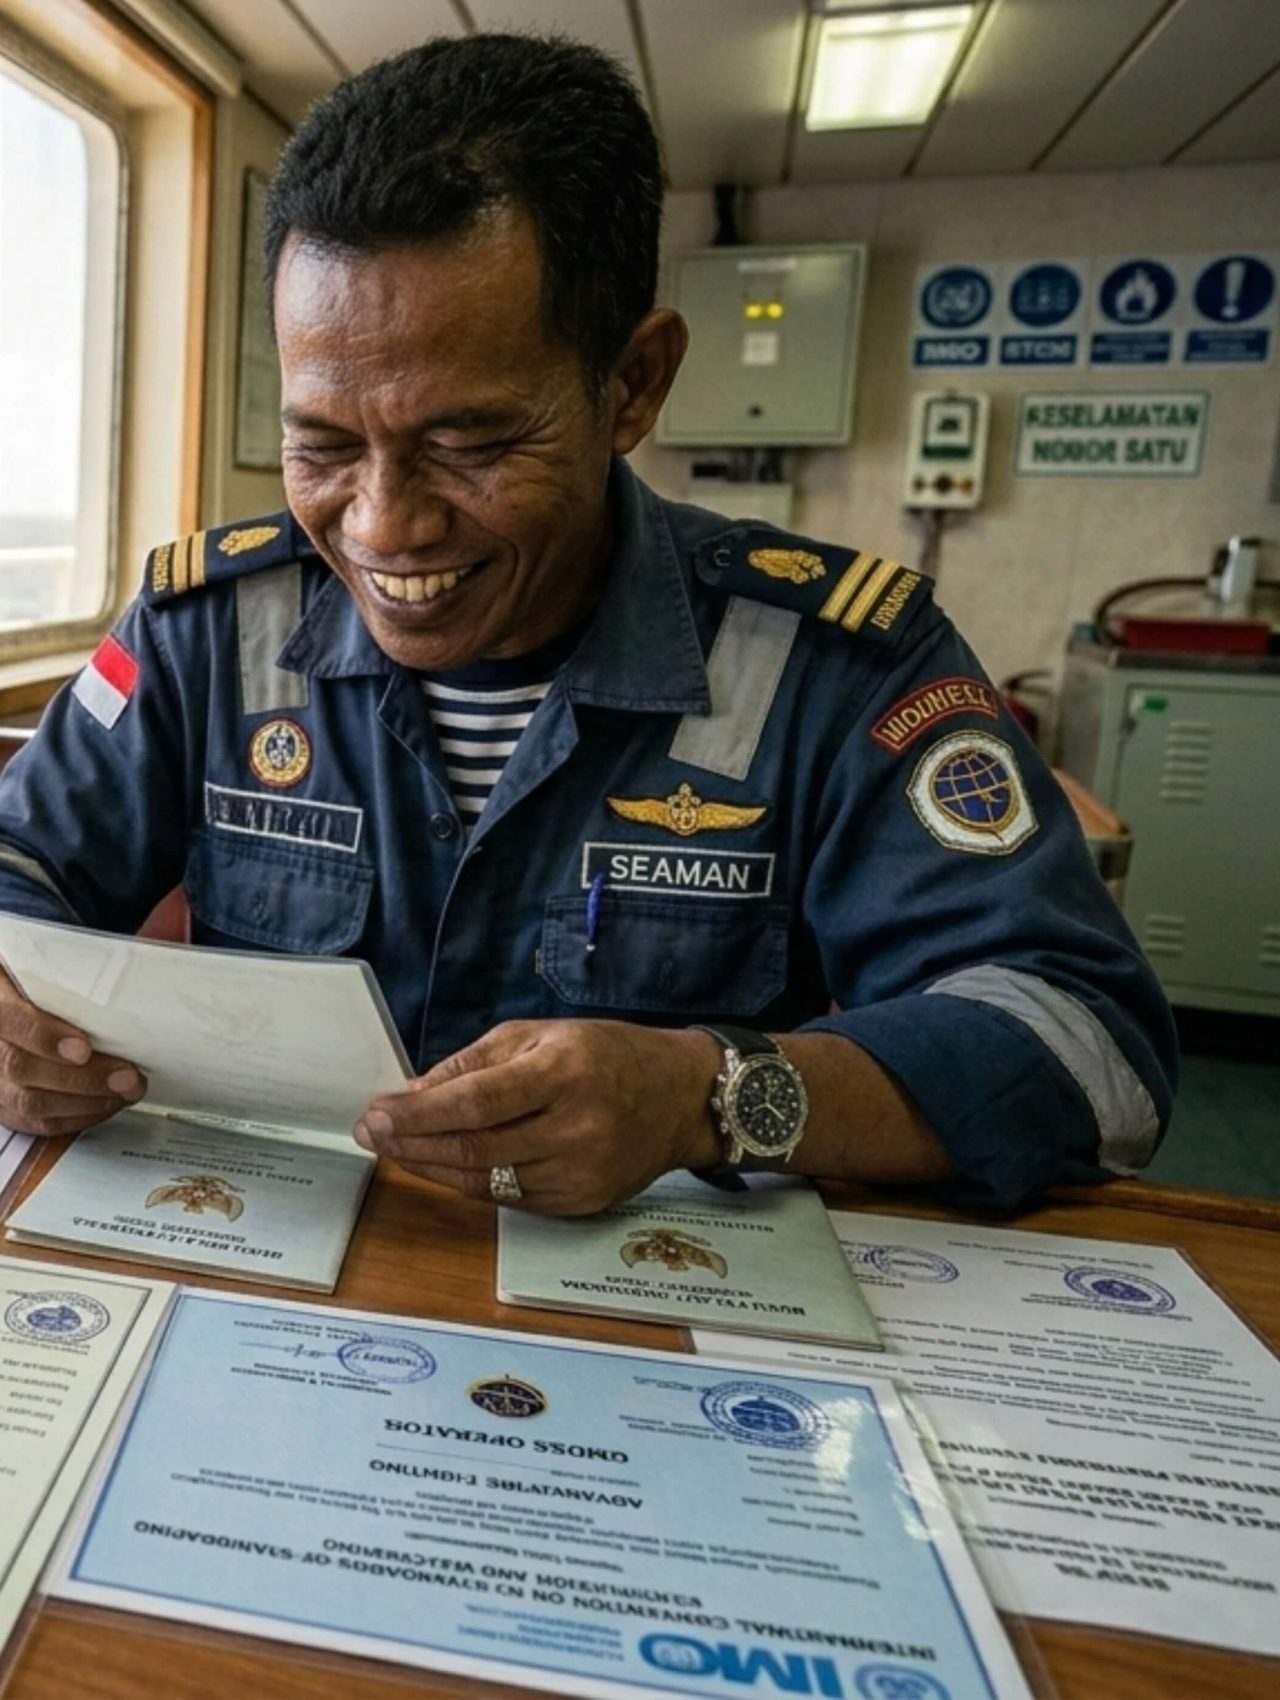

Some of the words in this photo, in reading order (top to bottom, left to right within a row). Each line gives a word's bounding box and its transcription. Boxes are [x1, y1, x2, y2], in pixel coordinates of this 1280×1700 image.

[1025, 403, 1200, 430] KESELAMATAN
[1125, 438, 1188, 465] SATU
[608, 854, 751, 890] SEAMAN
[640, 1635, 842, 1698] IMO
